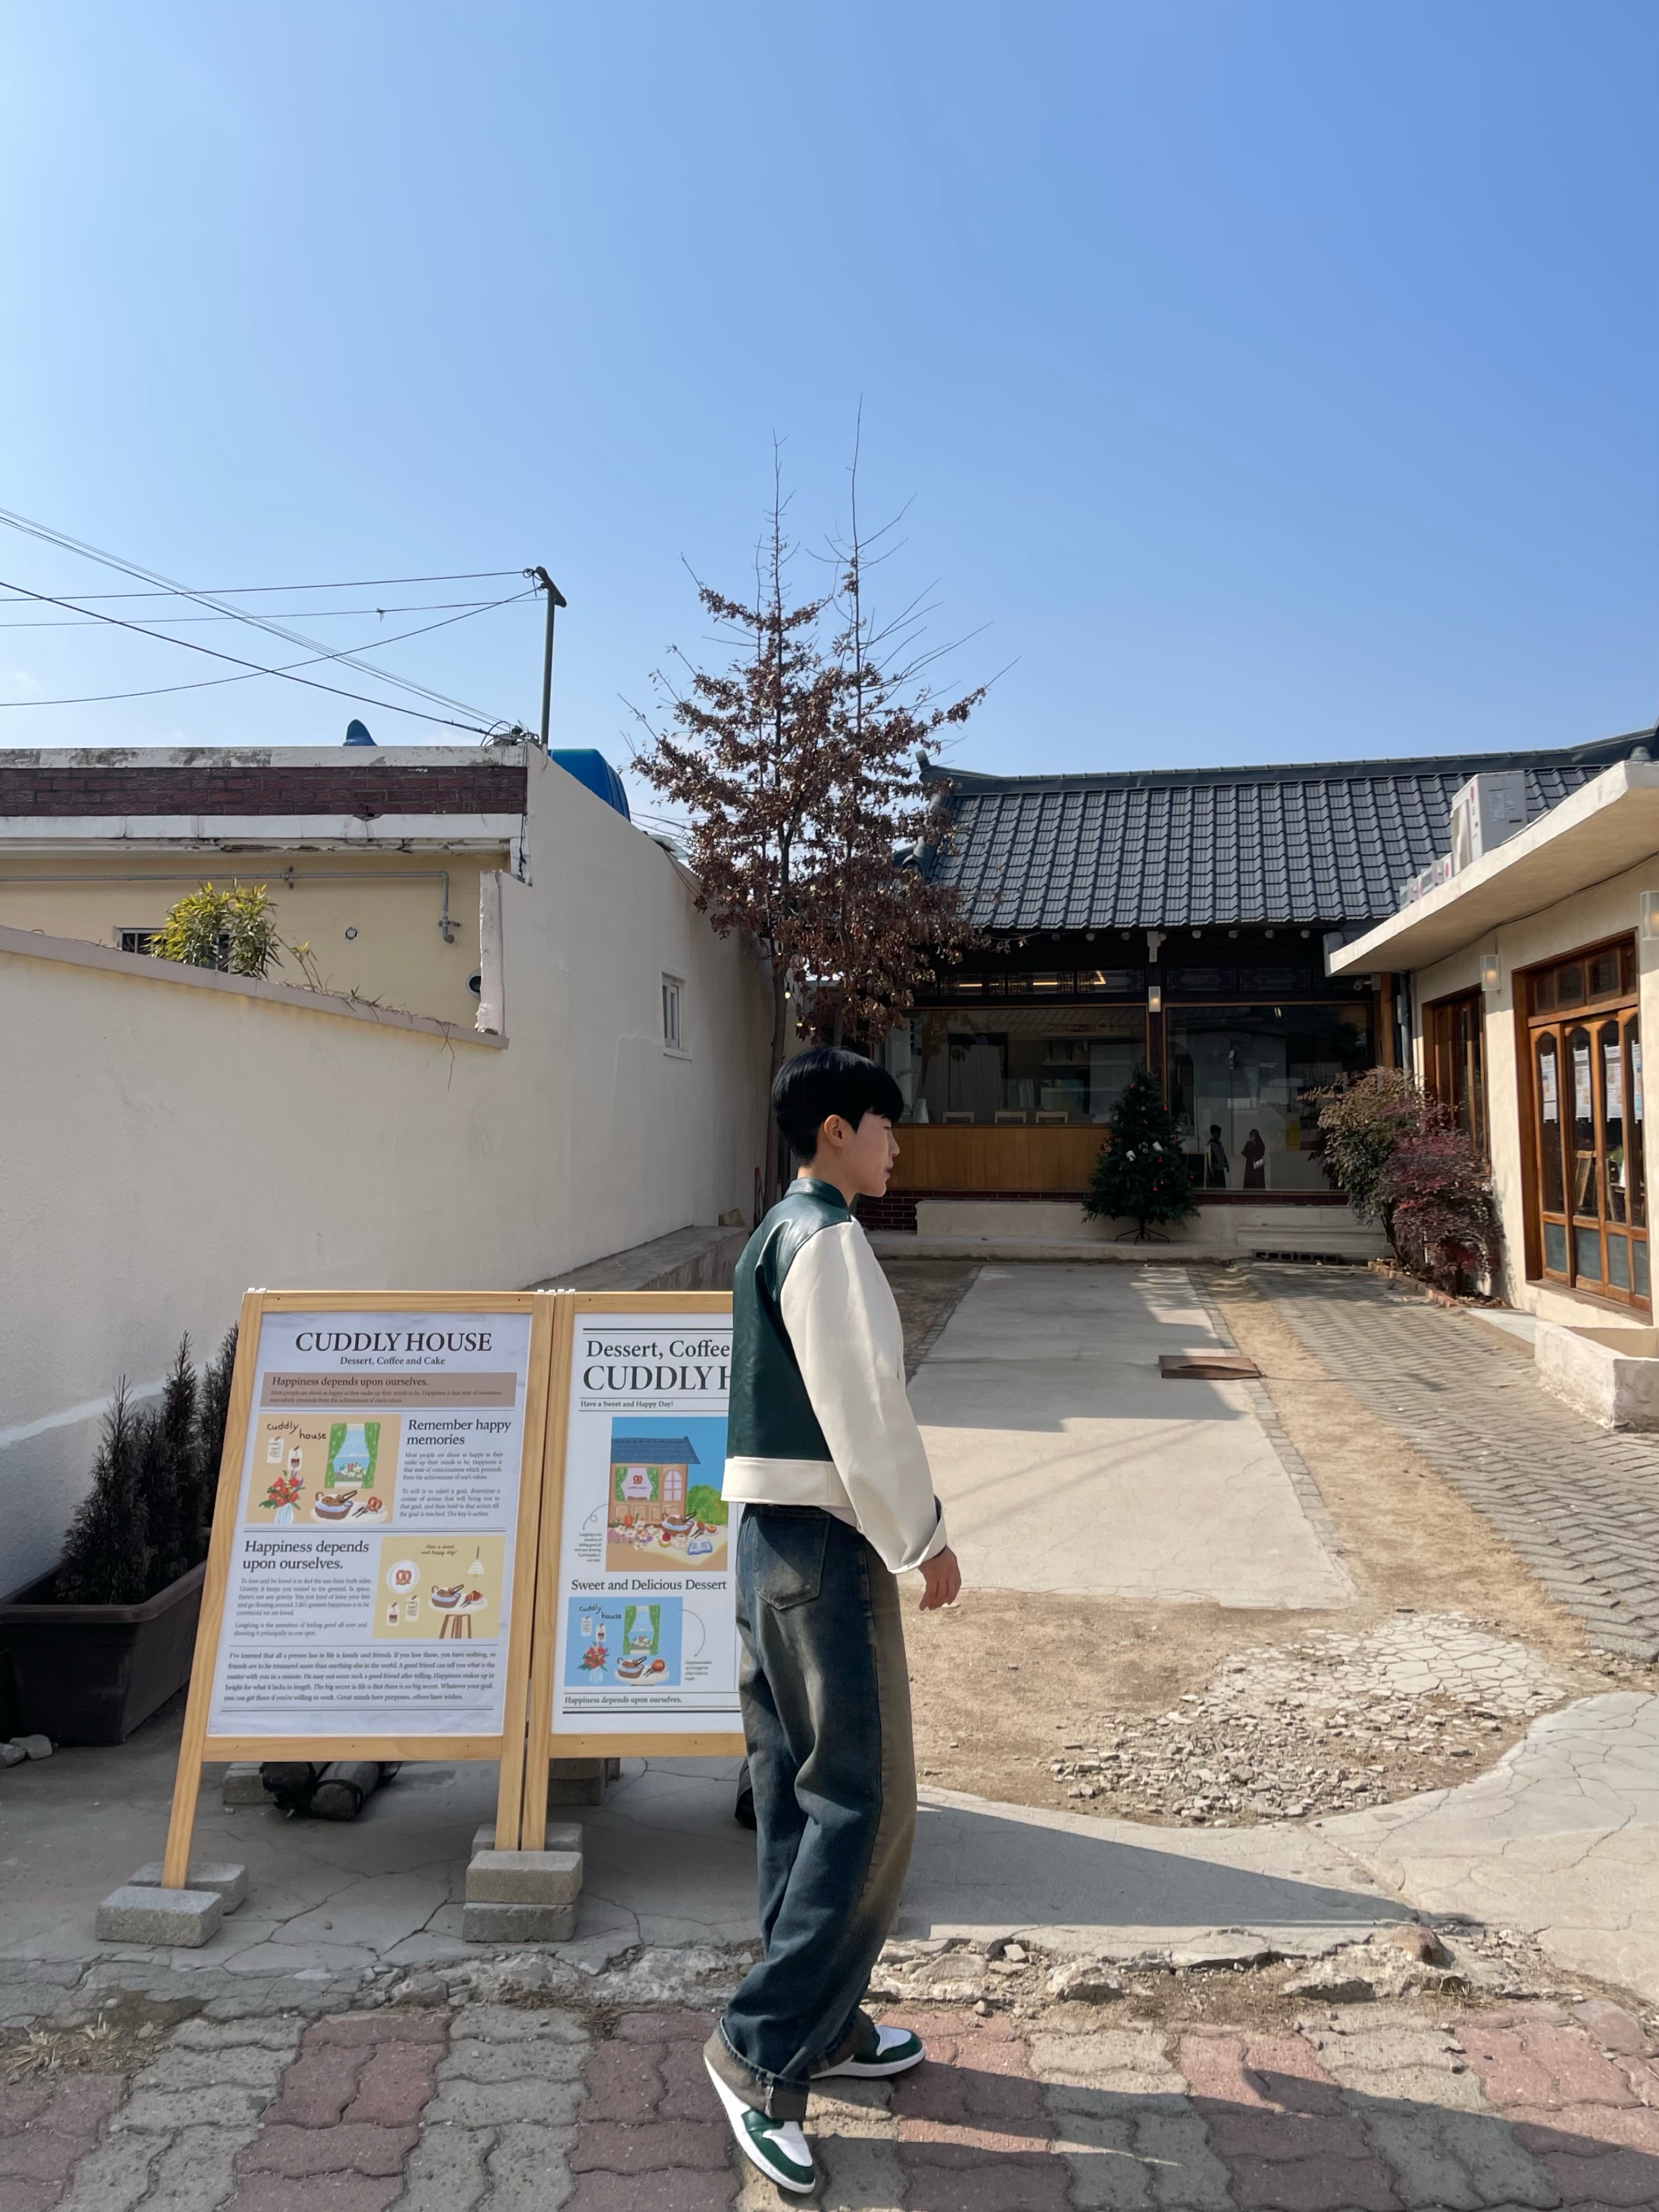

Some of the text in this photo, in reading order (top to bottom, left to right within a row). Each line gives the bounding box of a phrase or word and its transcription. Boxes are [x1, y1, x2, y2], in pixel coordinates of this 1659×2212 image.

[295, 1333, 492, 1352] CUDDLY HOUSE
[586, 1340, 730, 1360] Dessert, Coffee
[340, 1356, 445, 1366] Dessert, Coffee and Cake
[272, 1377, 428, 1388] Happiness depends upon ourselves.
[584, 1366, 714, 1390] CUDDLY
[636, 1401, 657, 1409] Happy
[266, 1421, 327, 1440] cuddly house
[408, 1419, 511, 1433] Remember happy
[407, 1434, 464, 1445] memories
[245, 1540, 369, 1556] Happiness depends
[243, 1557, 343, 1572] upon ourselves.
[571, 1580, 727, 1590] Sweet and Delicious Dessert
[579, 1605, 602, 1615] cuddly
[565, 1697, 600, 1705] Happiness
[601, 1696, 629, 1705] depends
